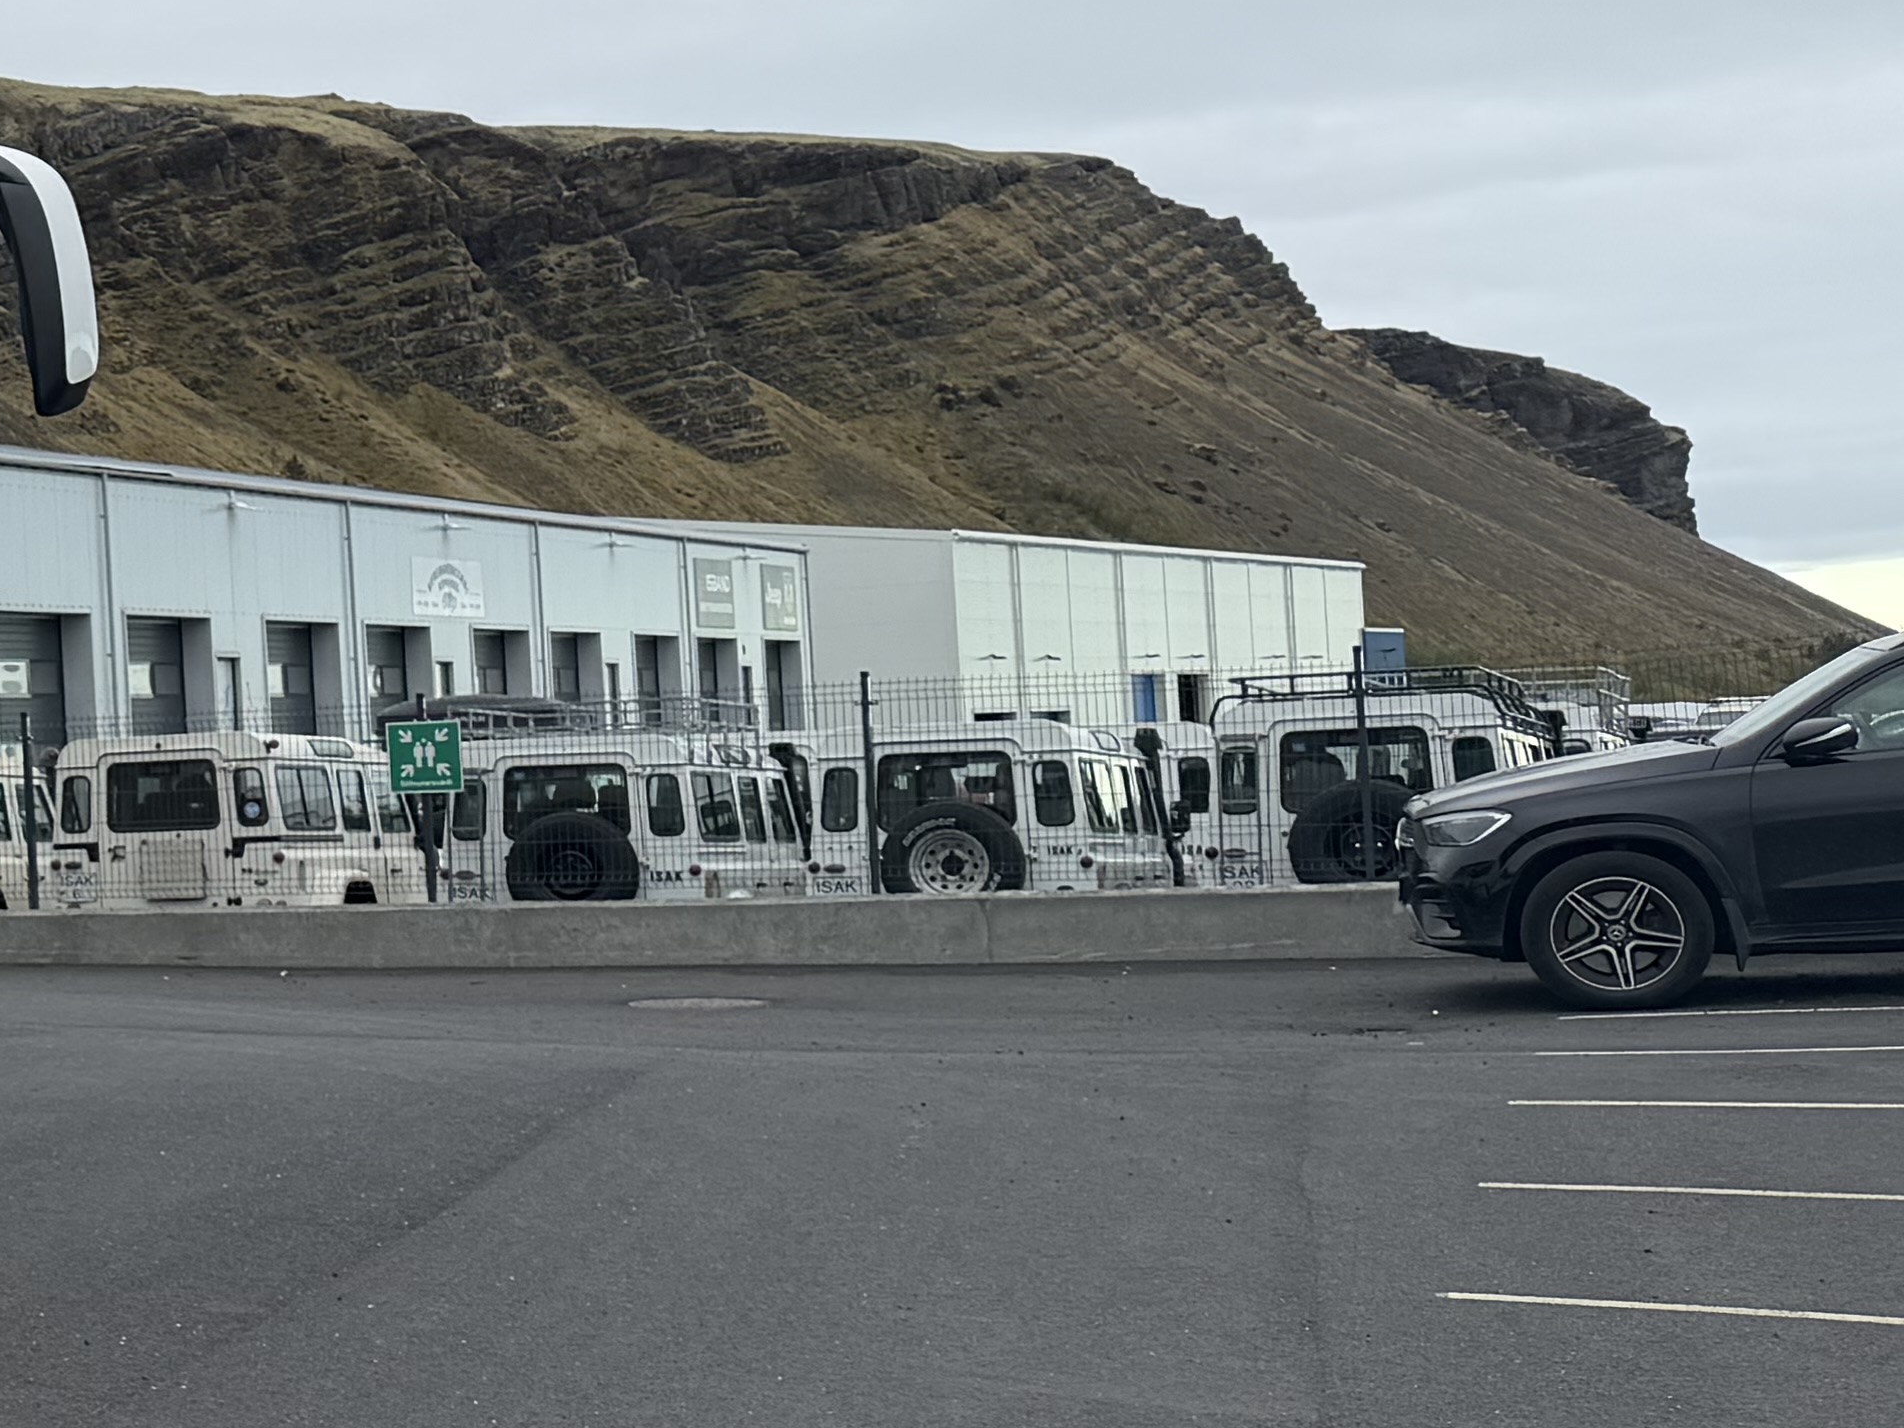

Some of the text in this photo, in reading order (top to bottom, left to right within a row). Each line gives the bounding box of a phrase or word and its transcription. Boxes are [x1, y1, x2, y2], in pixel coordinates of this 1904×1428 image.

[60, 875, 94, 887] ISAK
[650, 871, 683, 882] ISAK
[816, 880, 856, 894] ISAK
